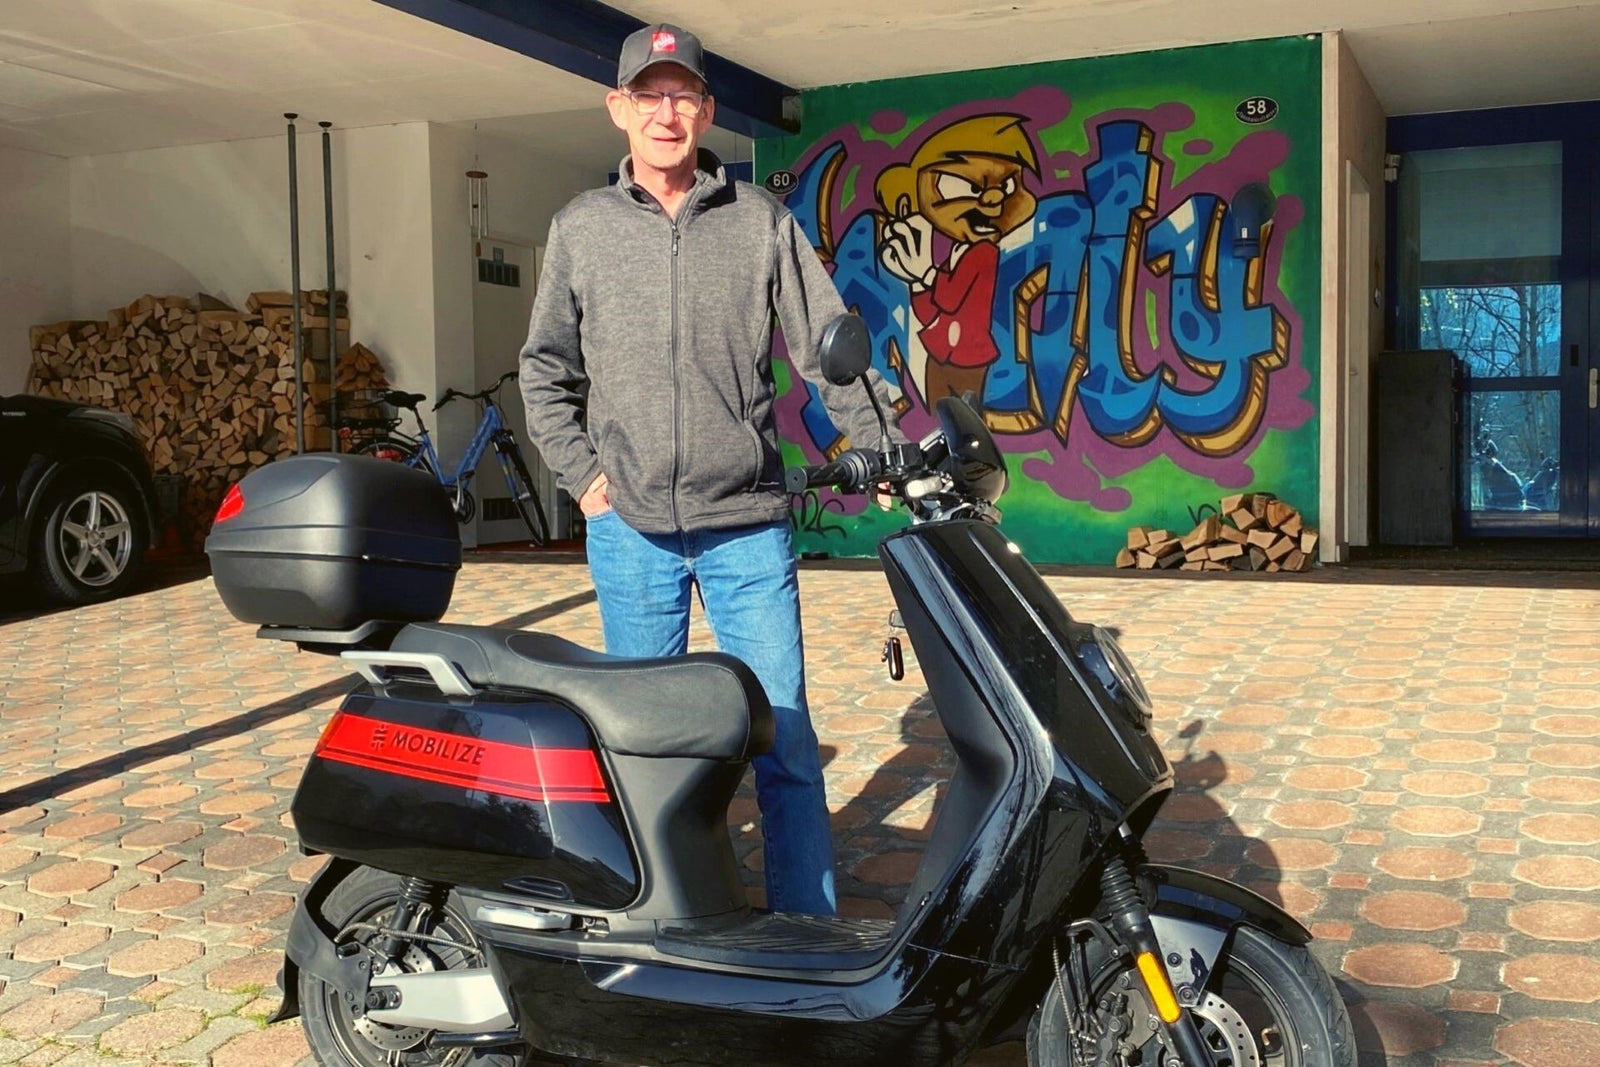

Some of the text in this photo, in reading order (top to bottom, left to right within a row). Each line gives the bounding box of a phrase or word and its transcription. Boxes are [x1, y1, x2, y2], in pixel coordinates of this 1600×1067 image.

[1247, 99, 1267, 115] 58
[773, 173, 790, 187] 60
[391, 730, 486, 766] MOBILIZE
